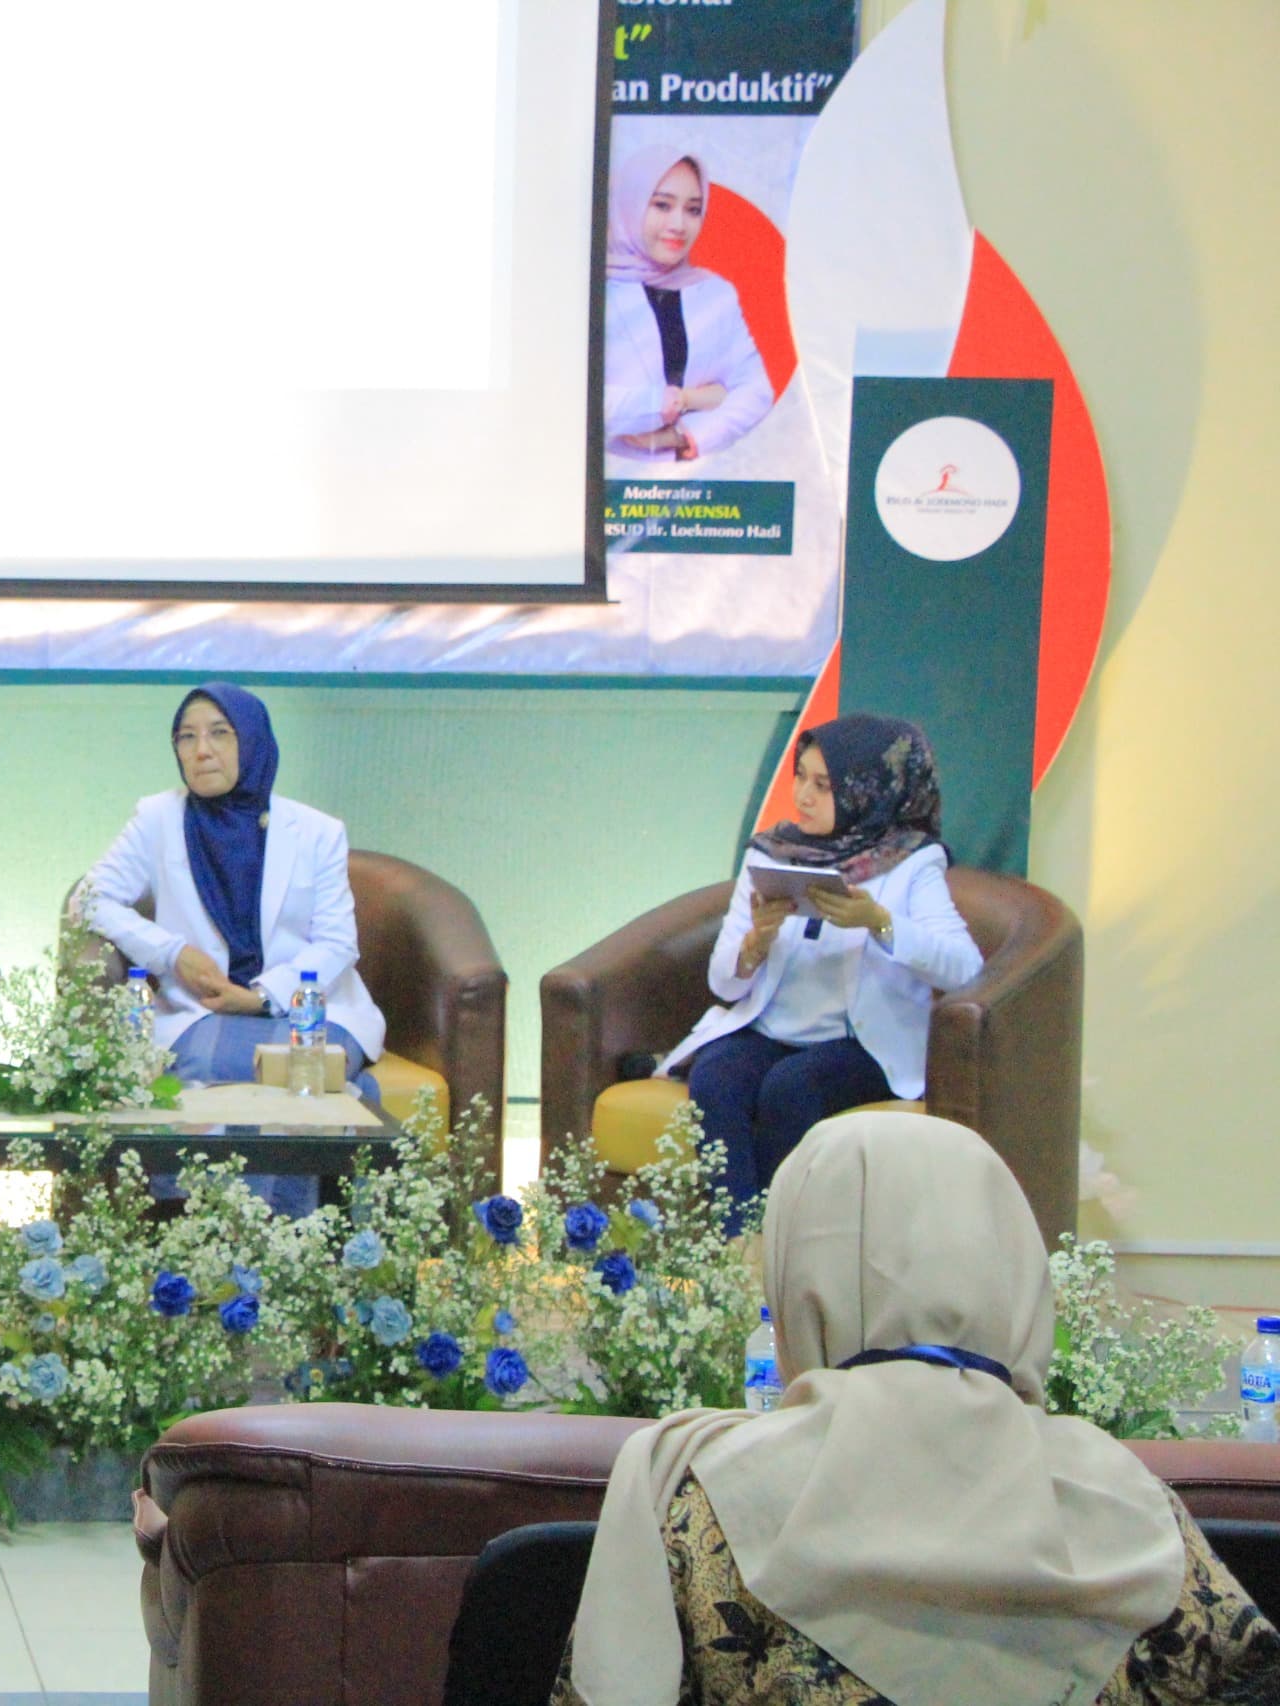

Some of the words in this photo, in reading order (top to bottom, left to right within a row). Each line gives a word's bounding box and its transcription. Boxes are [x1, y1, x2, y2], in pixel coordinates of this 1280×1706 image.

[623, 484, 702, 500] Moderator
[620, 504, 670, 519] TAURA
[673, 505, 741, 519] AVENSIA
[604, 523, 643, 536] RSUD
[646, 524, 667, 537] dr.
[671, 524, 744, 538] Loekmono
[747, 524, 781, 538] Hadi
